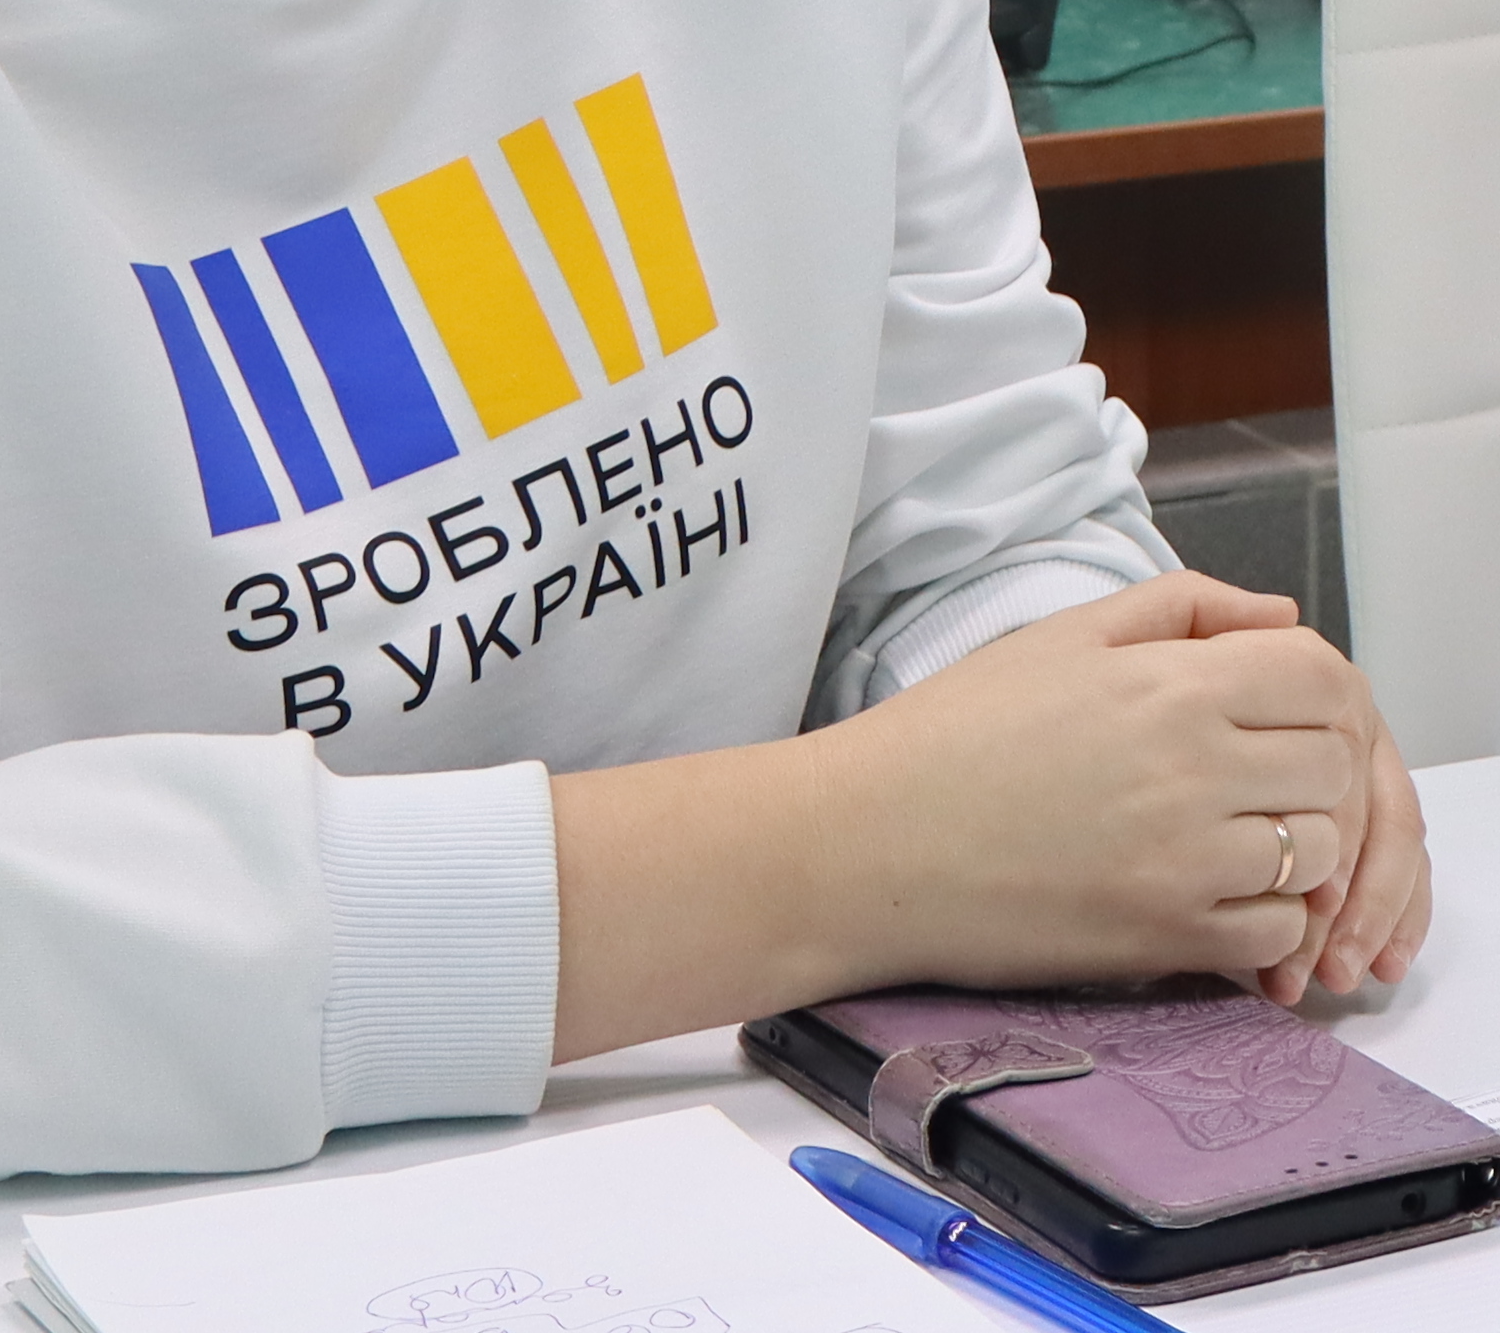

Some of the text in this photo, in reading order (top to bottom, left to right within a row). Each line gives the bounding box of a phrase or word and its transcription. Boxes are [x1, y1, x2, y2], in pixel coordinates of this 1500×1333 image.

[224, 375, 753, 652] ЗРОБЛЕНО
[282, 477, 749, 739] В УКРАЇНІ
